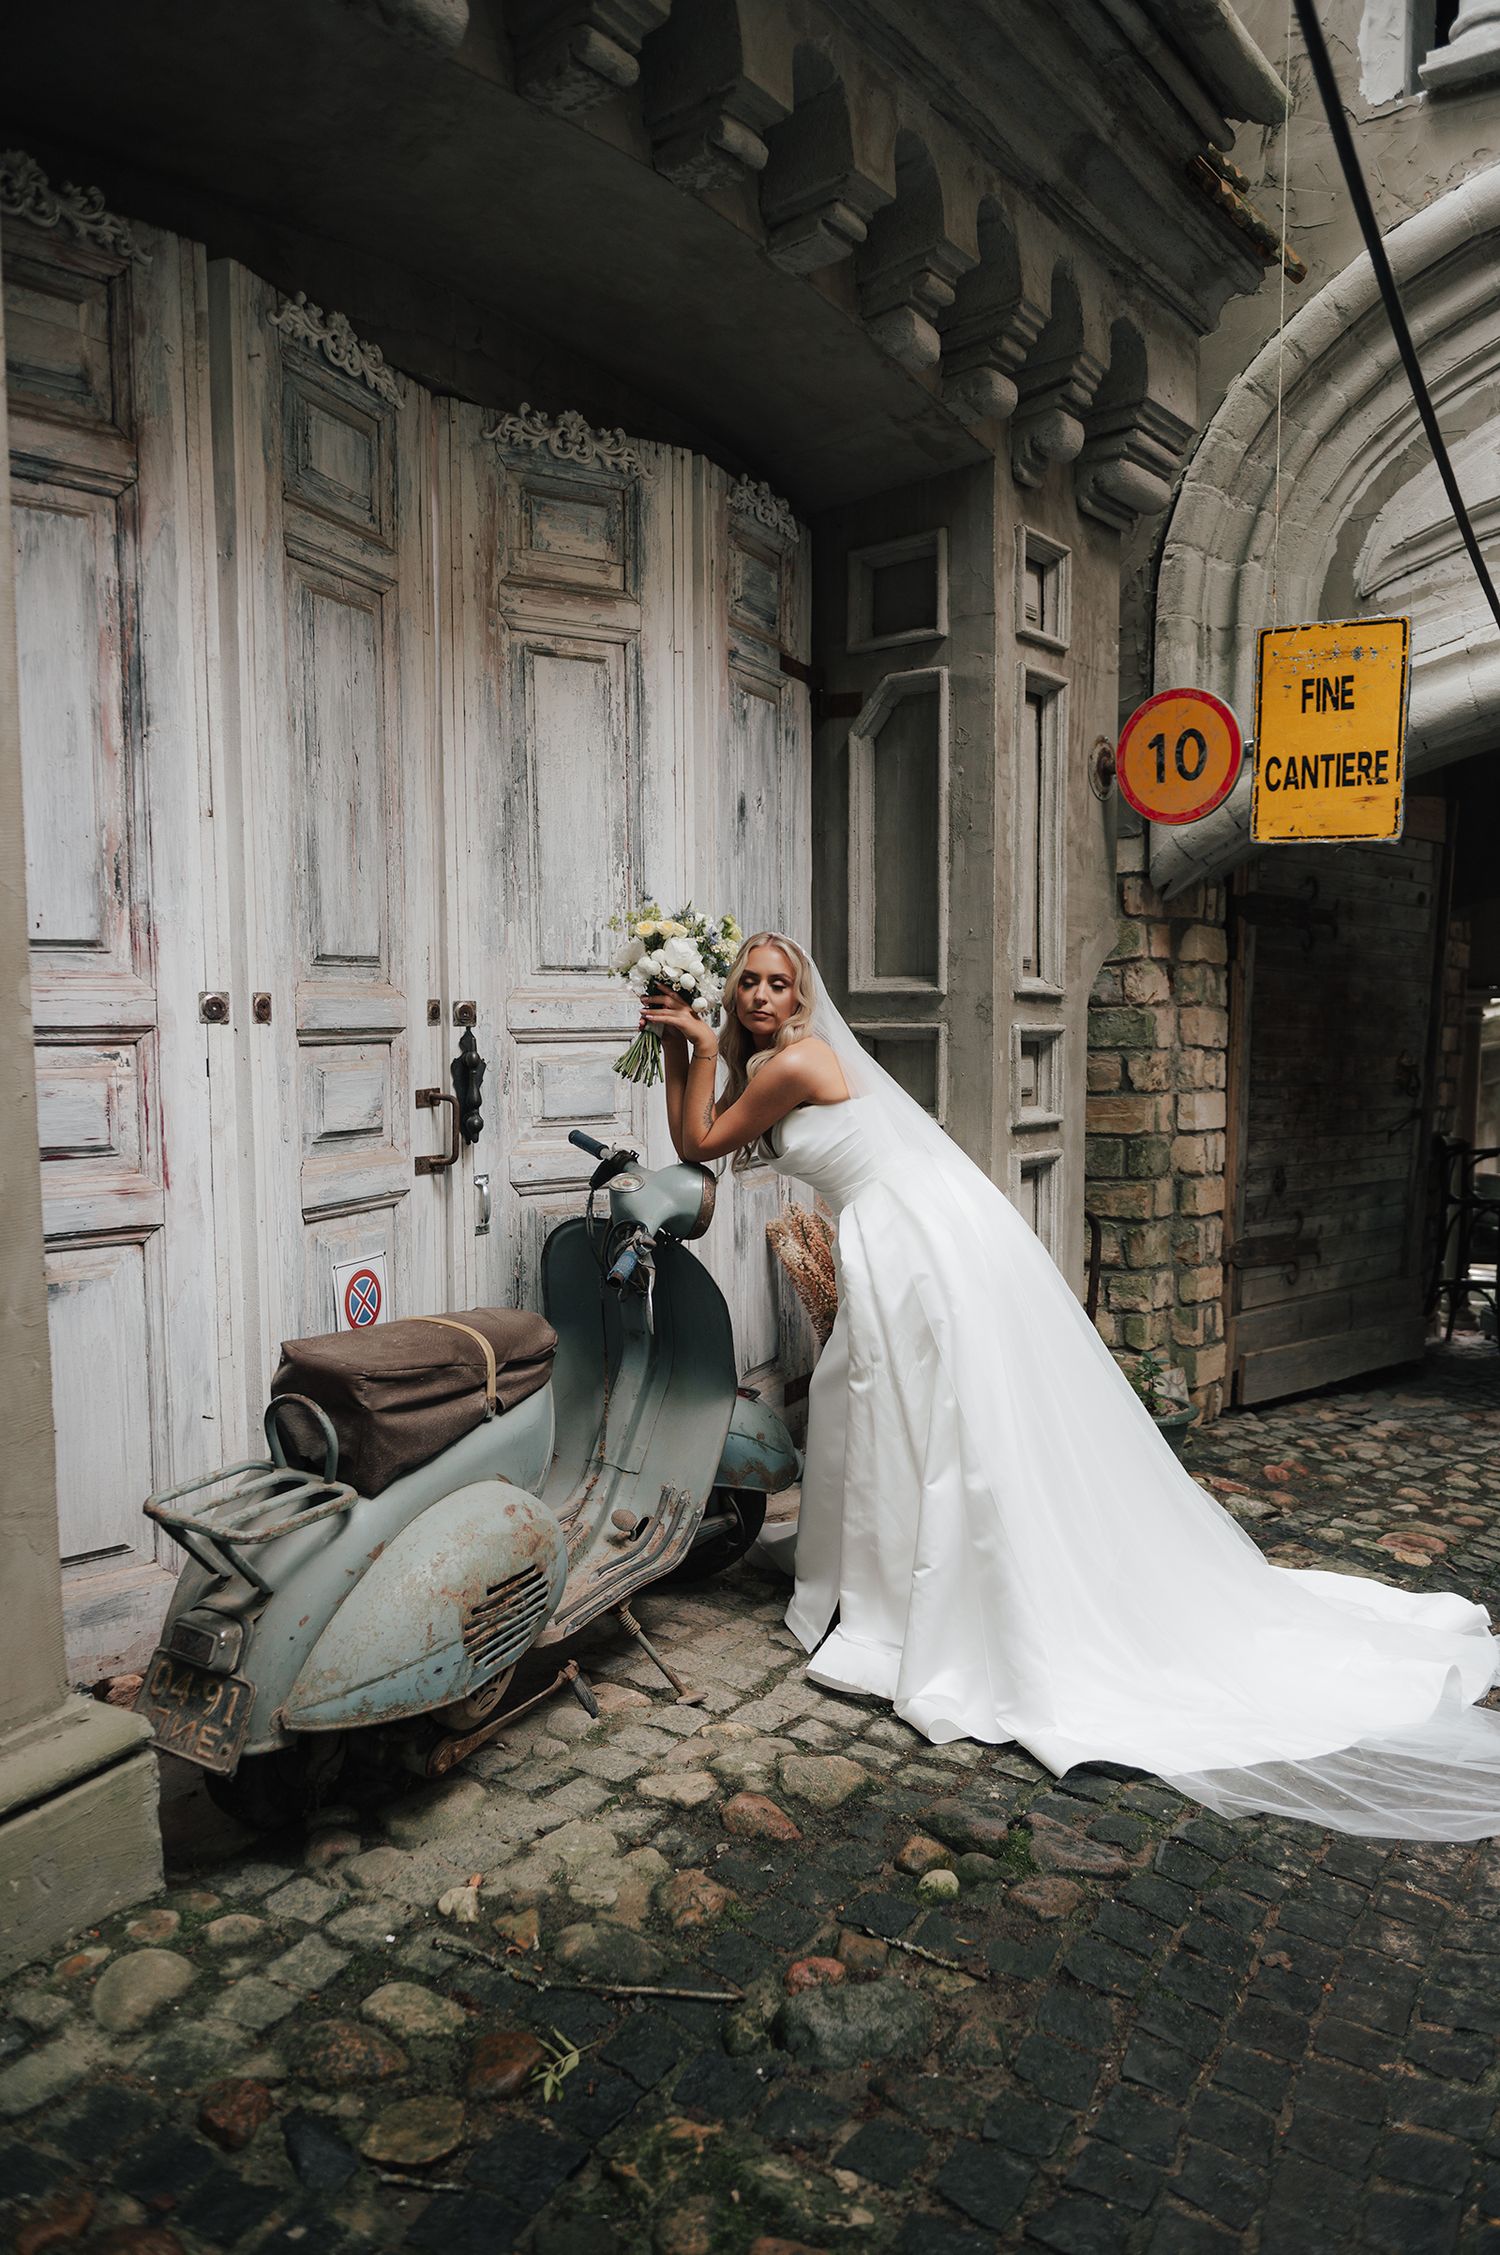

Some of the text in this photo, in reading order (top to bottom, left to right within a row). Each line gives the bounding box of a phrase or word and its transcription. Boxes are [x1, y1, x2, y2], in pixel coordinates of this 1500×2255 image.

[1301, 675, 1355, 714] FINE
[1148, 727, 1207, 783] 10
[1265, 749, 1390, 792] CANTIERE
